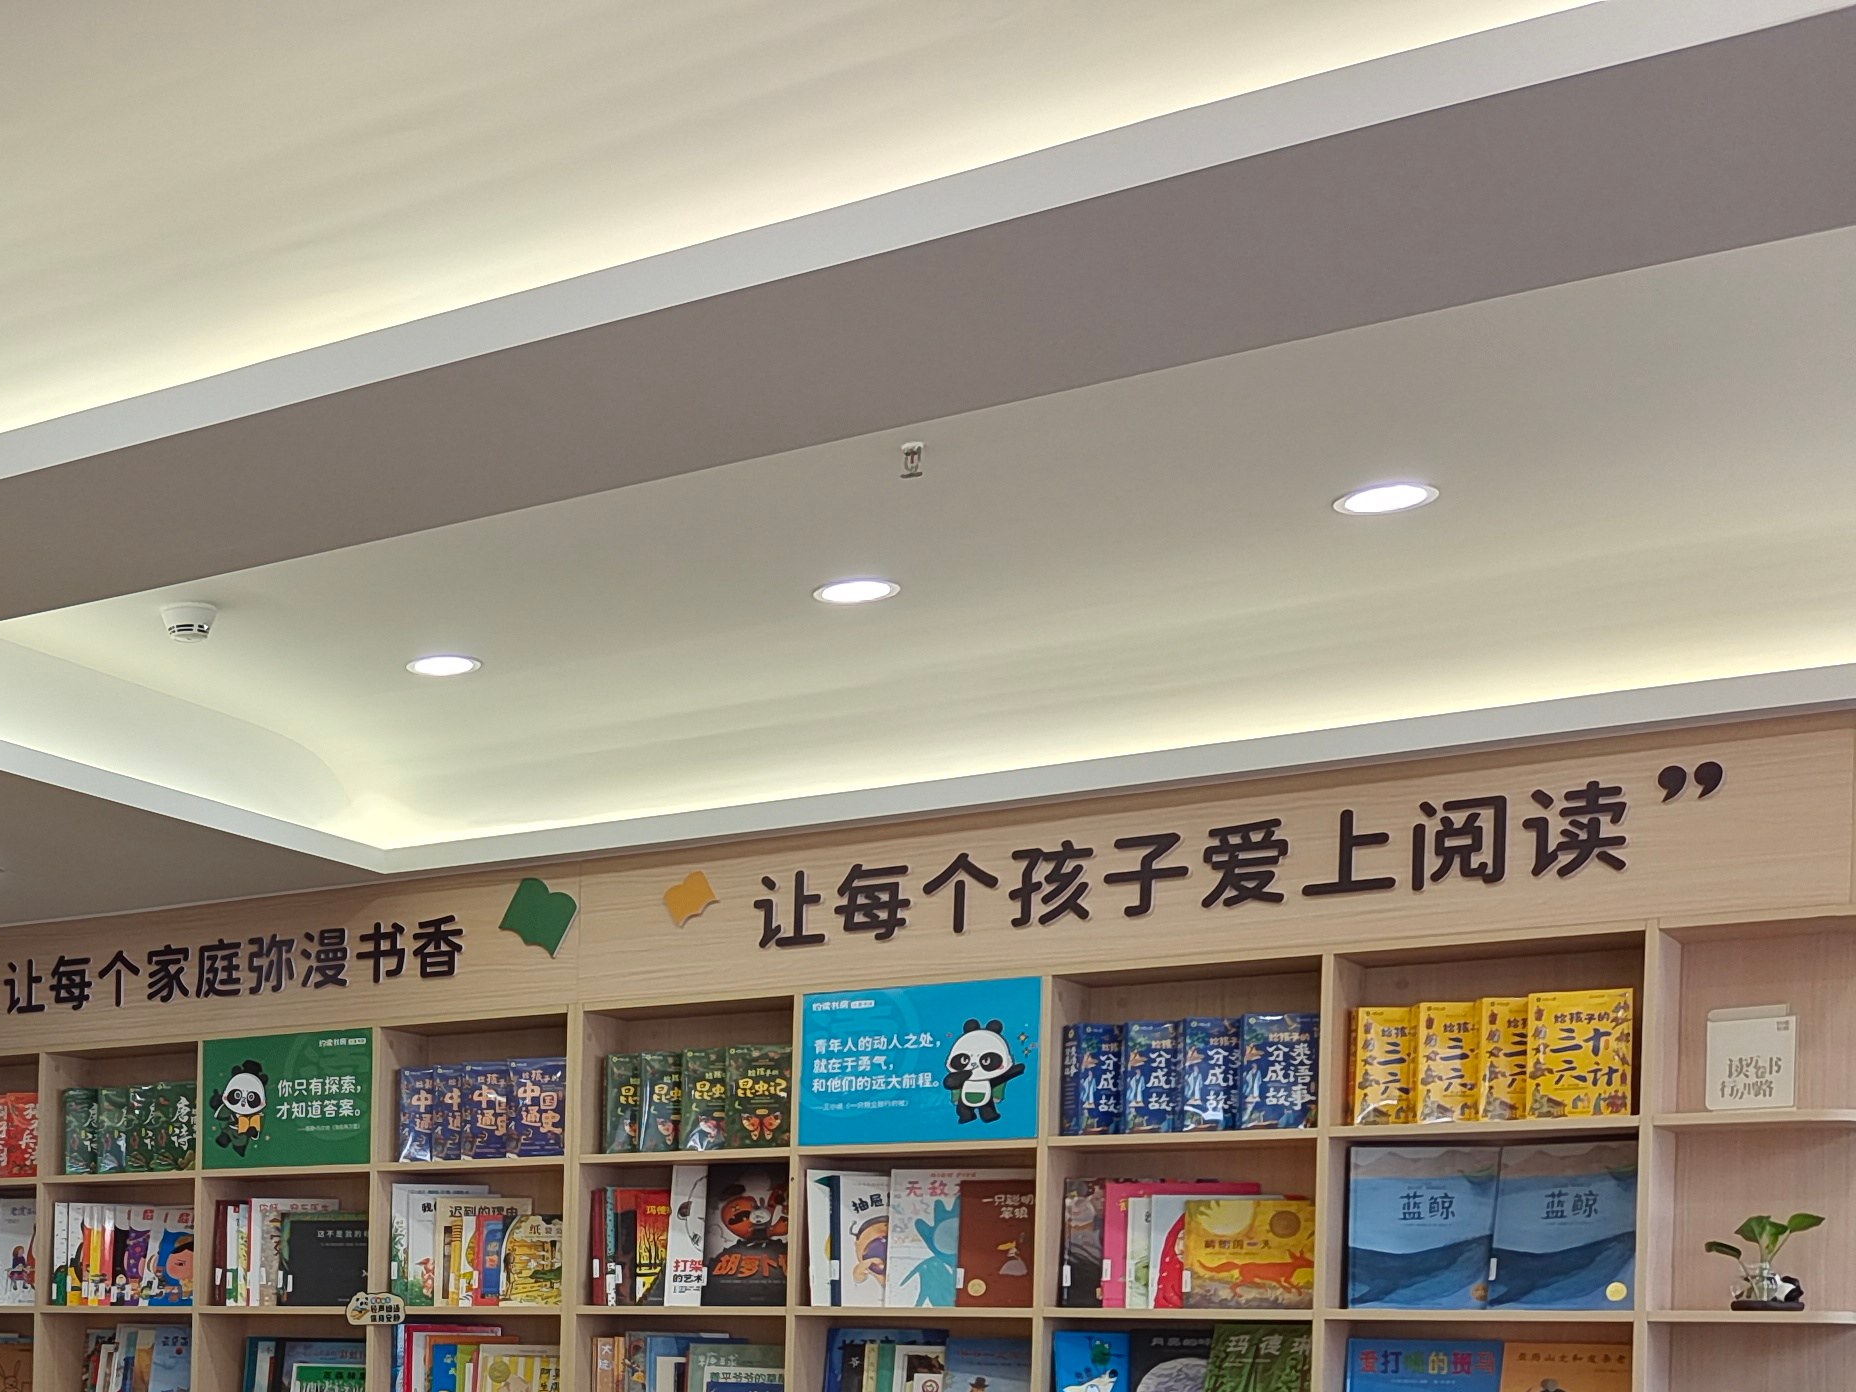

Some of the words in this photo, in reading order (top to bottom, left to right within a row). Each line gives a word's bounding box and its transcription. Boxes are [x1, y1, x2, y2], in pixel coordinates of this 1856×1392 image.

[1553, 1011, 1611, 1025] 给孩子的
[814, 1032, 941, 1055] 青年人的动人之处，
[1549, 1027, 1613, 1056] 三十
[813, 1055, 894, 1074] 就在于勇气，
[1554, 1059, 1620, 1087] 六计
[277, 1075, 362, 1098] 你只有探索，
[736, 1077, 787, 1099] 昆虫记
[812, 1072, 940, 1094] 和他们的远大前程。
[276, 1099, 362, 1120] 才知道答案。
[1398, 1190, 1456, 1222] 蓝鲸
[1540, 1189, 1599, 1220] 蓝鲸
[673, 1258, 704, 1273] 打架
[672, 1273, 704, 1284] 的艺术
